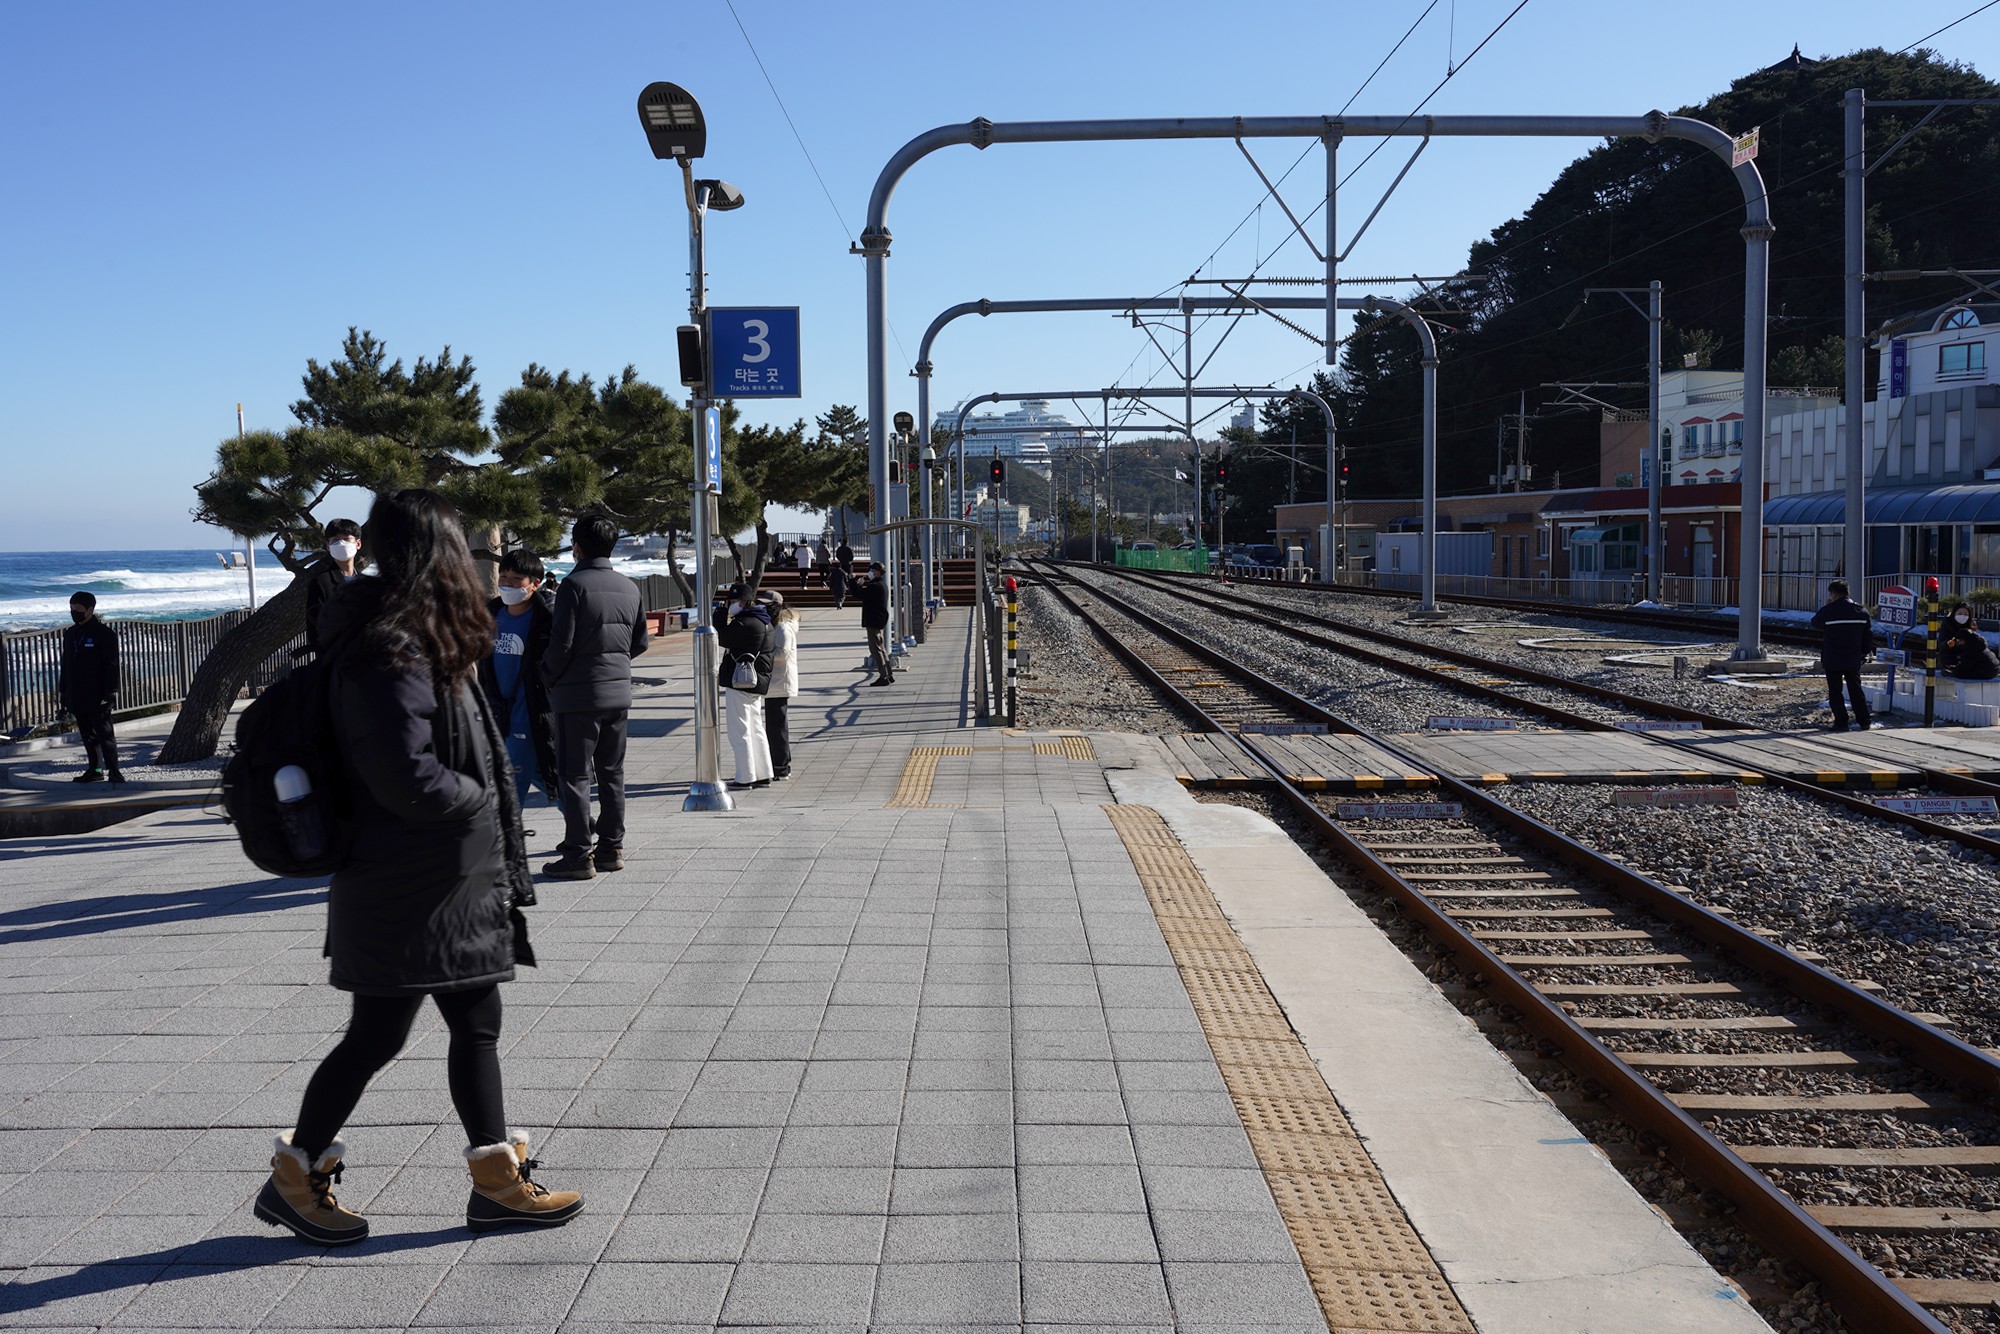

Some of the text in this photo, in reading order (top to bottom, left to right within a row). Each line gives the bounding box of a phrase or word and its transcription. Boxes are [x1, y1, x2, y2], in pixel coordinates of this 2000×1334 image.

[742, 319, 771, 363] 3
[735, 368, 779, 383] 타는 곳
[729, 384, 750, 392] Tracks
[1217, 490, 1224, 500] 2
[495, 647, 511, 655] FACE
[1920, 800, 1952, 808] DANGER
